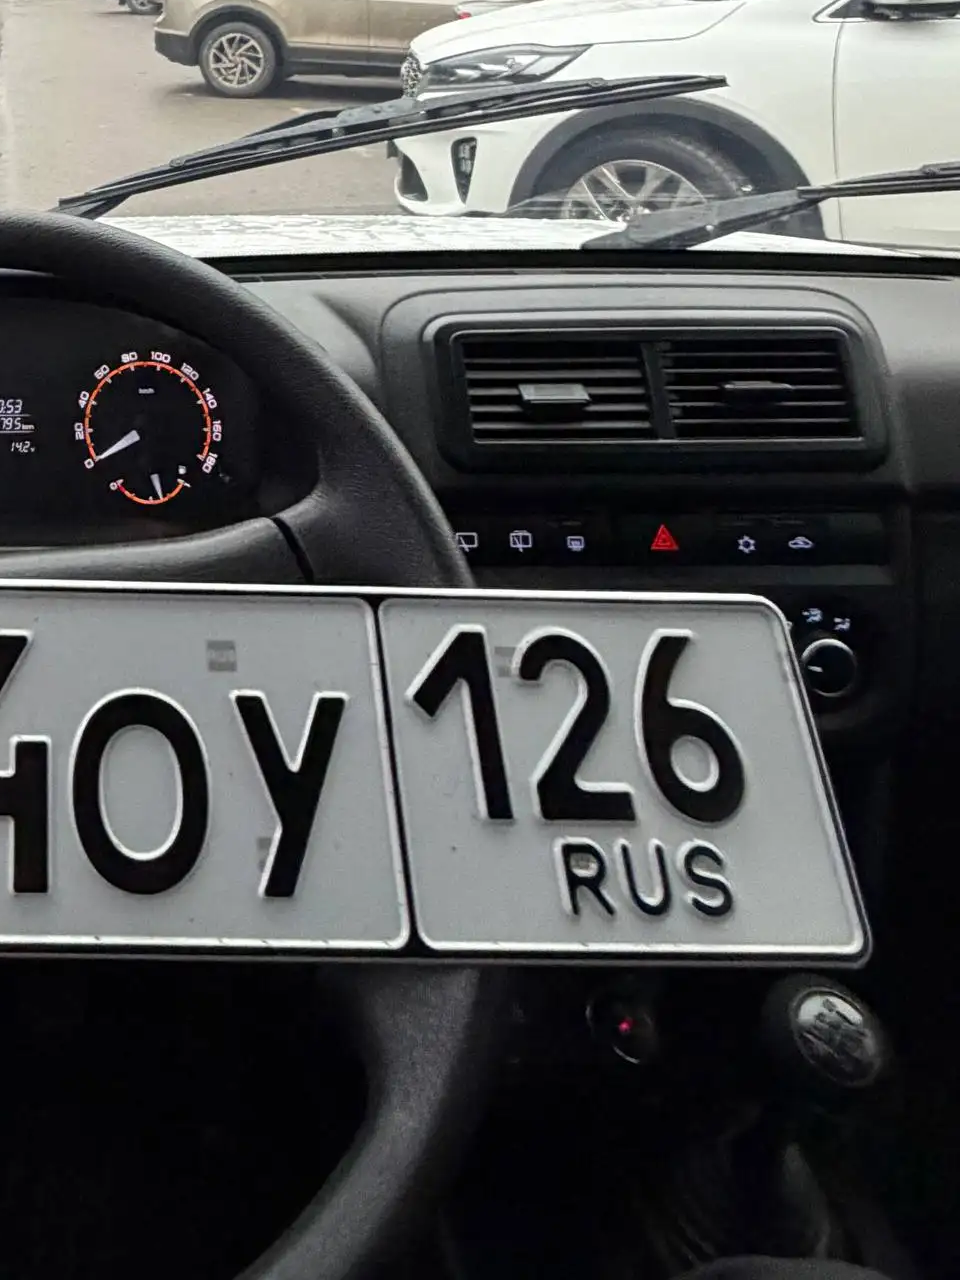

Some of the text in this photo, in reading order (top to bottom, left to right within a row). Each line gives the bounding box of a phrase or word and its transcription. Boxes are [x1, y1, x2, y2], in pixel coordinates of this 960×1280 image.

[150, 351, 171, 363] 100
[93, 364, 110, 380] 60
[180, 363, 199, 381] 120
[78, 391, 90, 408] 40
[202, 388, 218, 409] 140
[74, 422, 84, 440] 20
[212, 420, 222, 442] 160
[83, 458, 95, 469] 0
[201, 452, 218, 474] 180
[405, 625, 745, 823] 126
[554, 836, 735, 918] RUS
